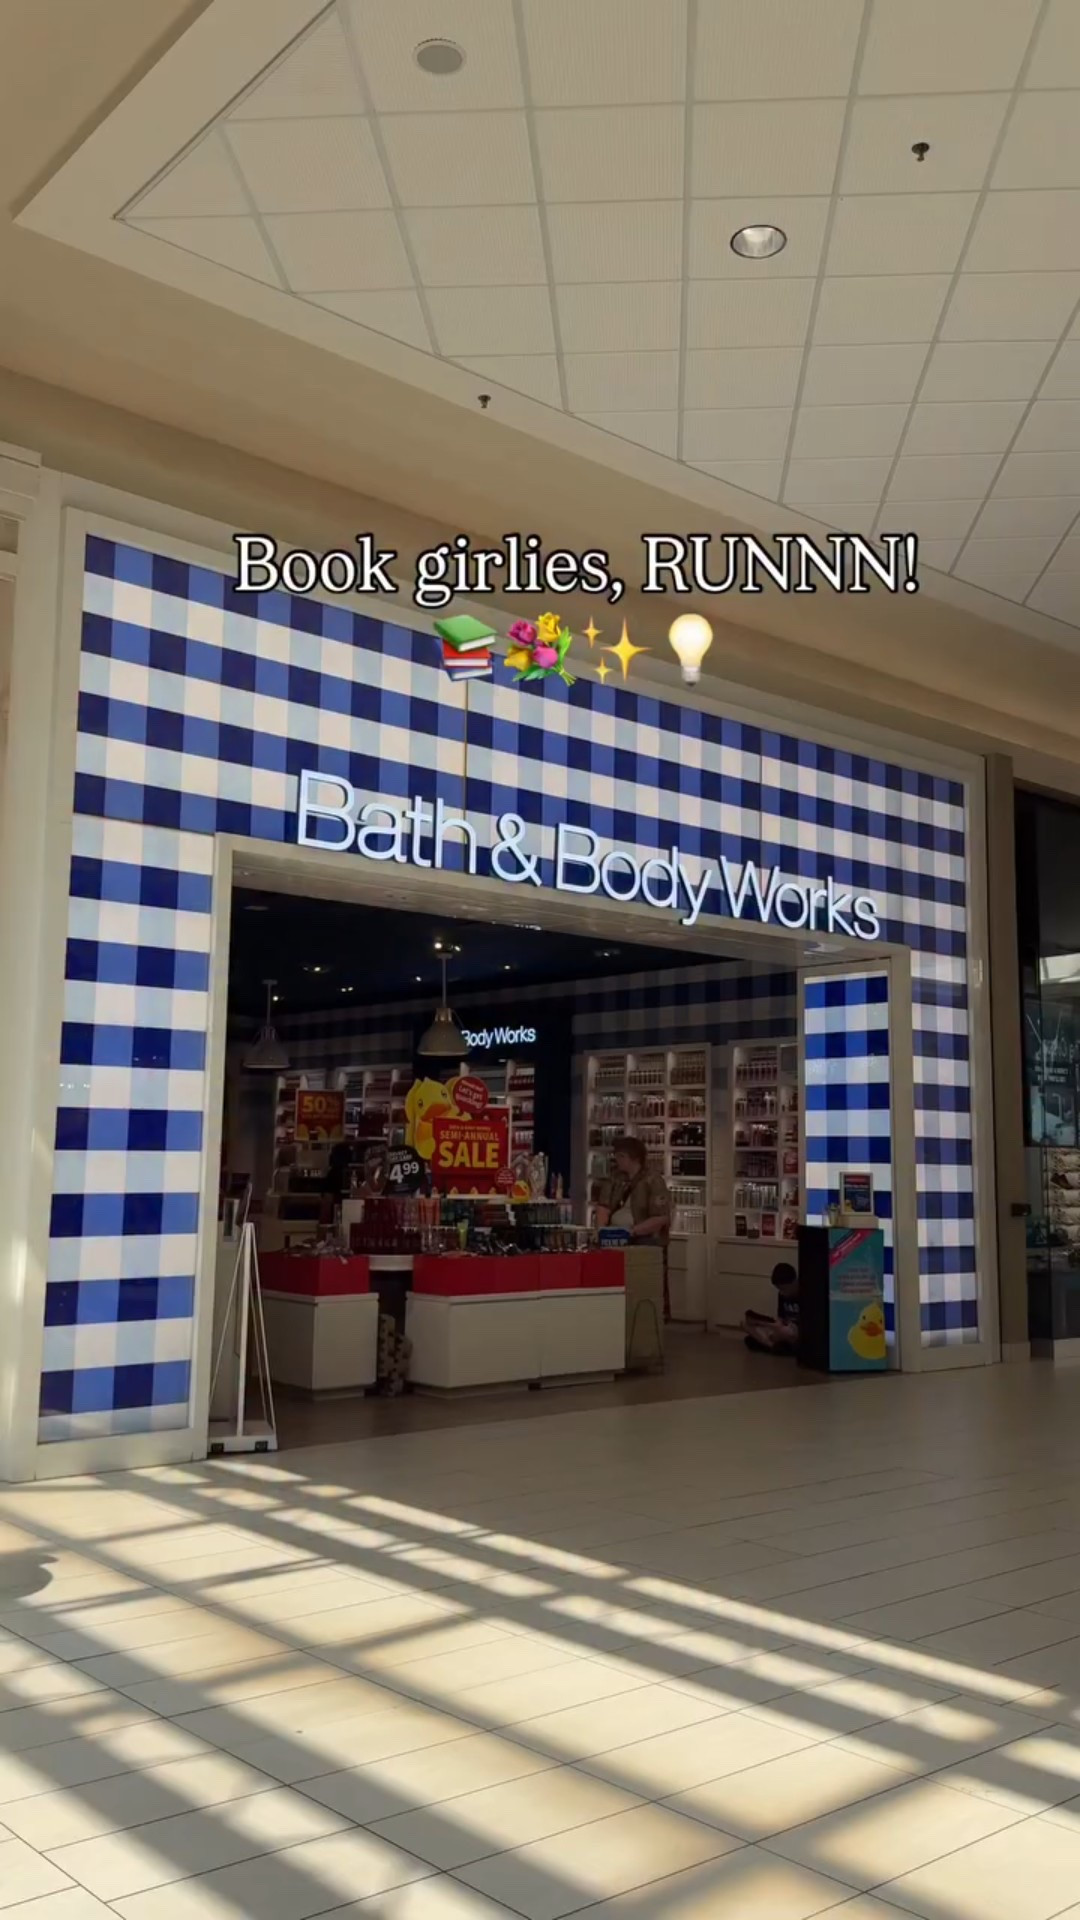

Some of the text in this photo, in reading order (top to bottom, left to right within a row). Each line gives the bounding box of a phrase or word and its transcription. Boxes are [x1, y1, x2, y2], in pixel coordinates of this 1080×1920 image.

[297, 769, 881, 941] Bath & Body Works
[494, 1025, 536, 1044] Works
[440, 1129, 499, 1142] SEMI-ANNUAL
[439, 1141, 499, 1168] SALE
